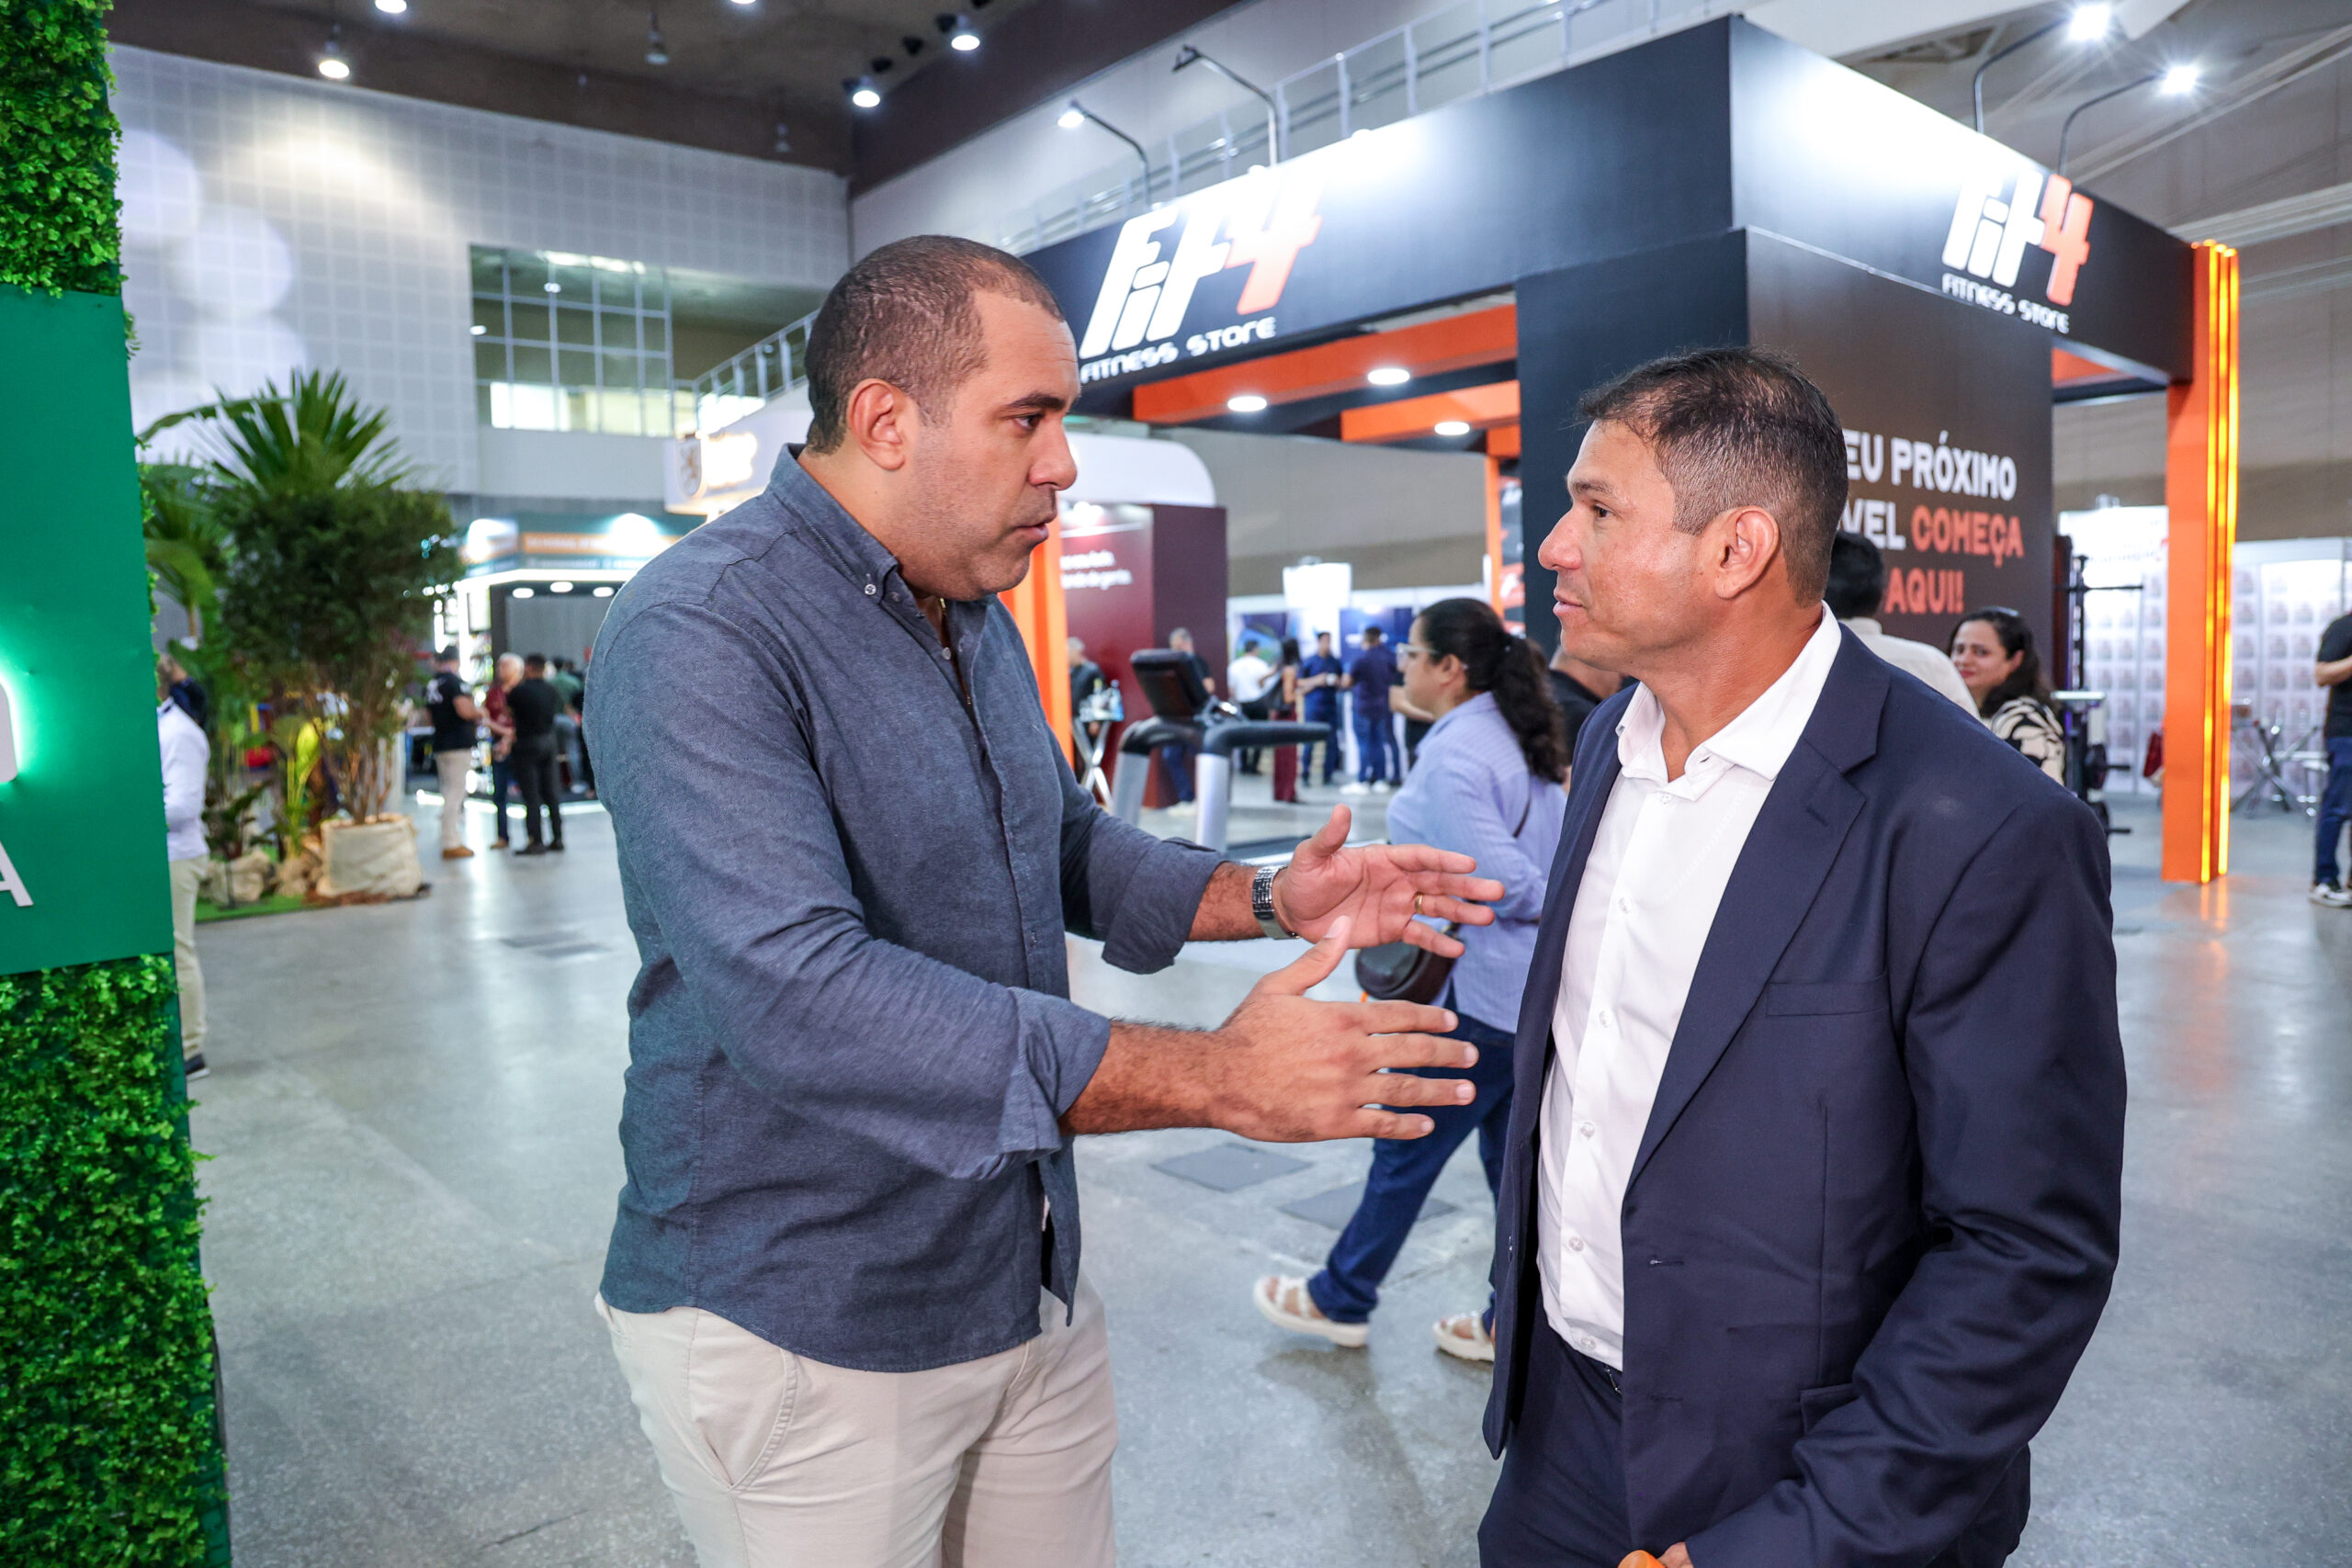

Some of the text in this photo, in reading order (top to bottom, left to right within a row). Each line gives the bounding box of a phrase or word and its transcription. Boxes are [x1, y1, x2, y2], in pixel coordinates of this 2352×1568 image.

[1842, 428, 2017, 502] EU PRÓXIMO
[1911, 504, 2024, 569] COMEÇA
[1884, 567, 1964, 615] AQUI!
